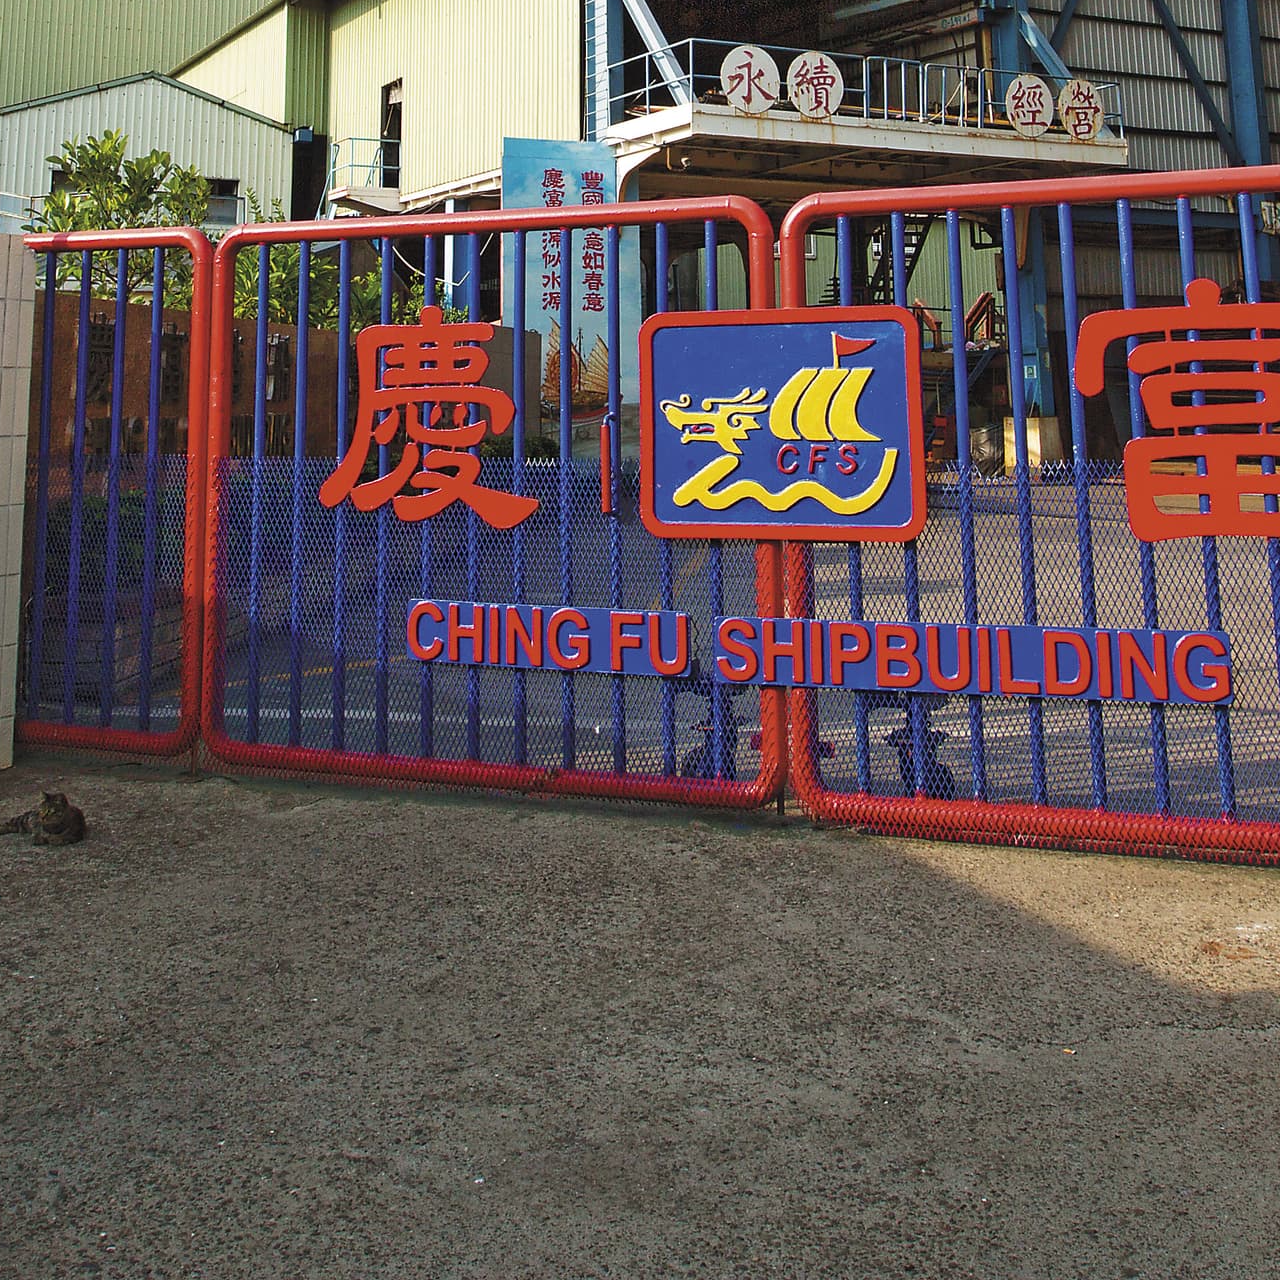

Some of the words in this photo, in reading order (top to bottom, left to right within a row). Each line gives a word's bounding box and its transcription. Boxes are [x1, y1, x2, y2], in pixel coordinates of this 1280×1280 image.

[542, 168, 565, 311] 慶富源似水源
[581, 170, 604, 311] 豐國意如春意
[776, 444, 858, 475] CFS
[407, 600, 591, 670] CHING
[610, 610, 688, 675] FU
[716, 618, 1229, 702] SHIPBUILDING
